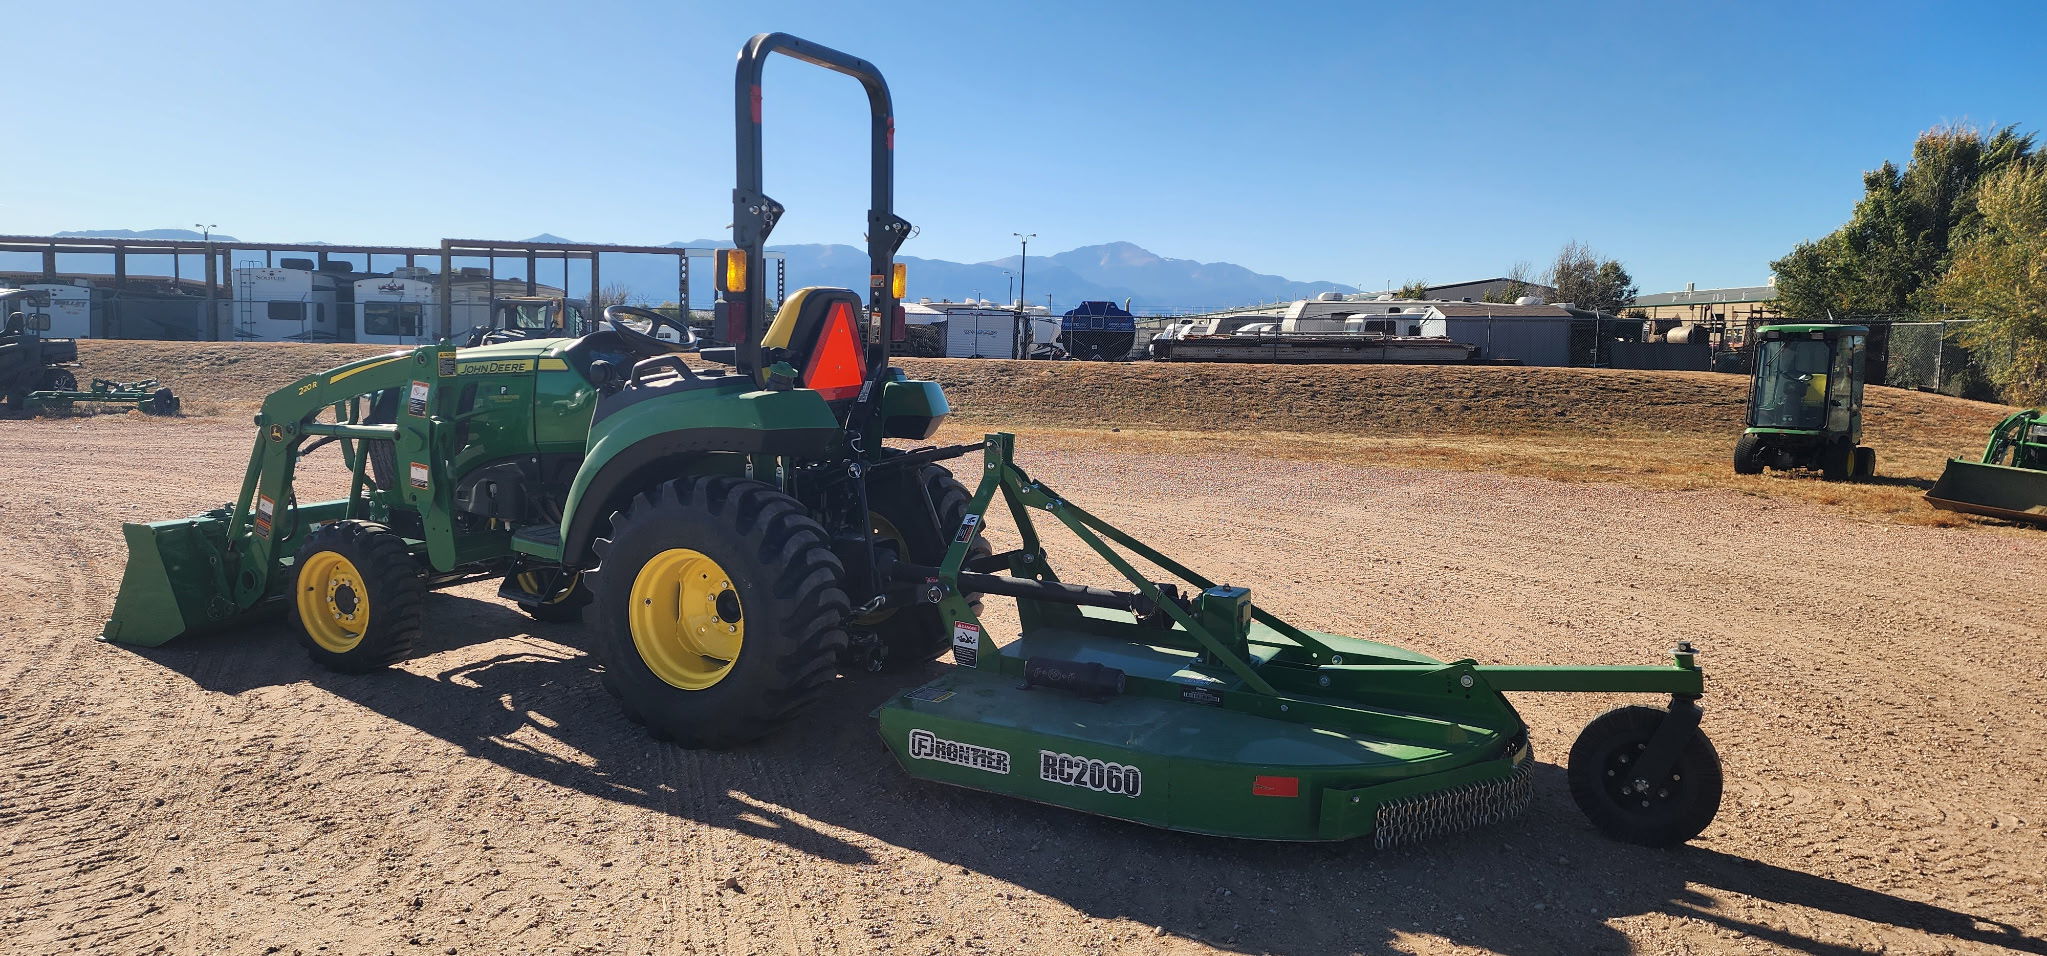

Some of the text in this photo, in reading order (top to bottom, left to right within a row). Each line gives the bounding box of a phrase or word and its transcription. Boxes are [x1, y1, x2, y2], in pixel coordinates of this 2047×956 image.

[461, 364, 489, 374] JOHN
[489, 362, 526, 373] DEERE
[911, 731, 1008, 772] FRONTIER
[1042, 753, 1140, 796] RC2060
